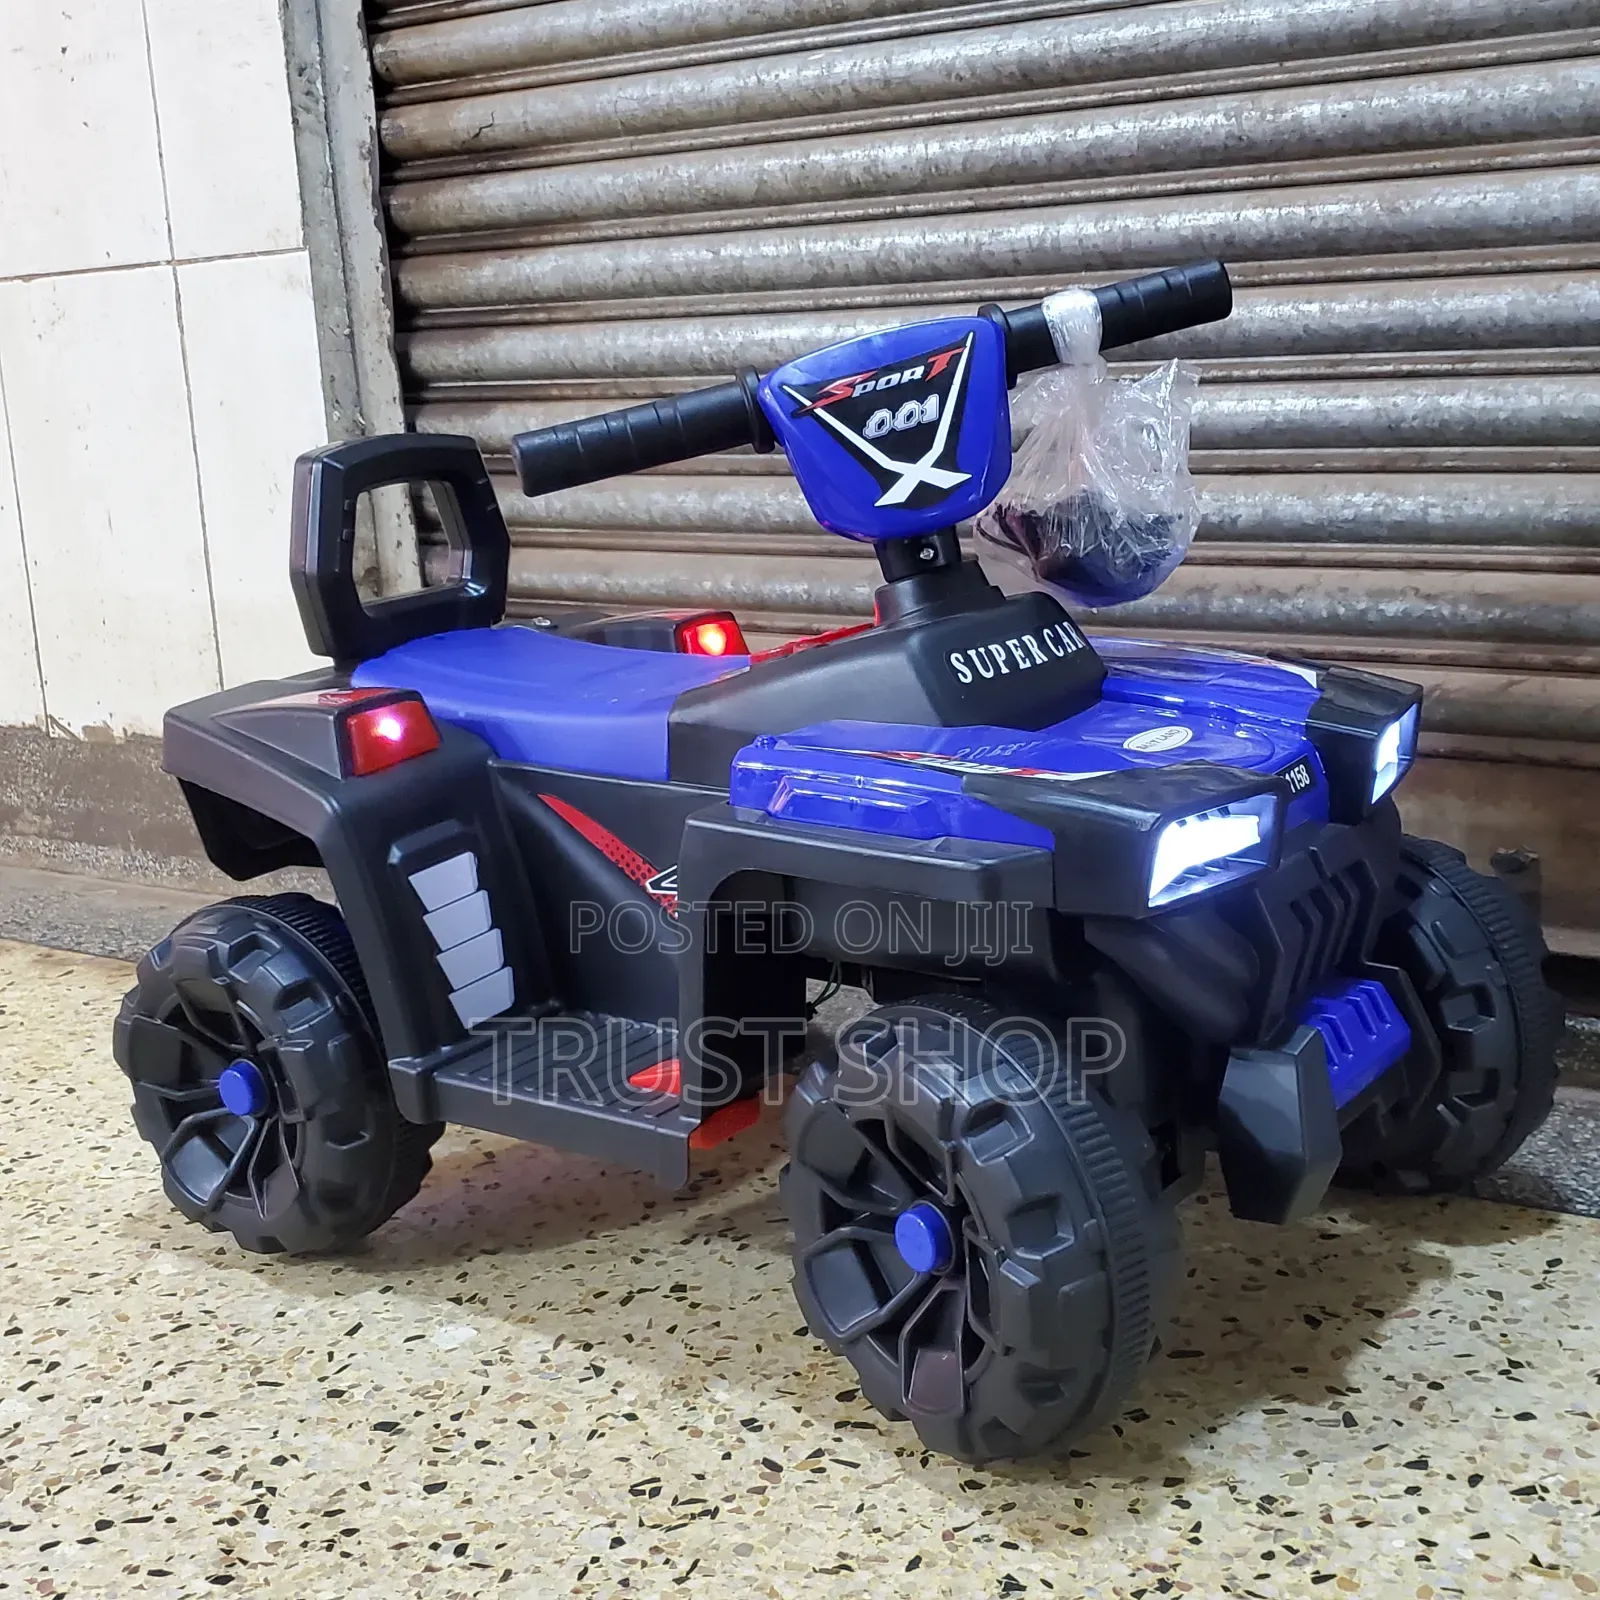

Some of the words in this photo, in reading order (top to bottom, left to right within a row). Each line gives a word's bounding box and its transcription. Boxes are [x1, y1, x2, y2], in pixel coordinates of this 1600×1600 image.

[801, 347, 965, 412] SPORT
[862, 394, 940, 439] 001
[950, 634, 1049, 684] SUPER
[1043, 621, 1087, 657] CAR
[1285, 764, 1310, 793] 1158
